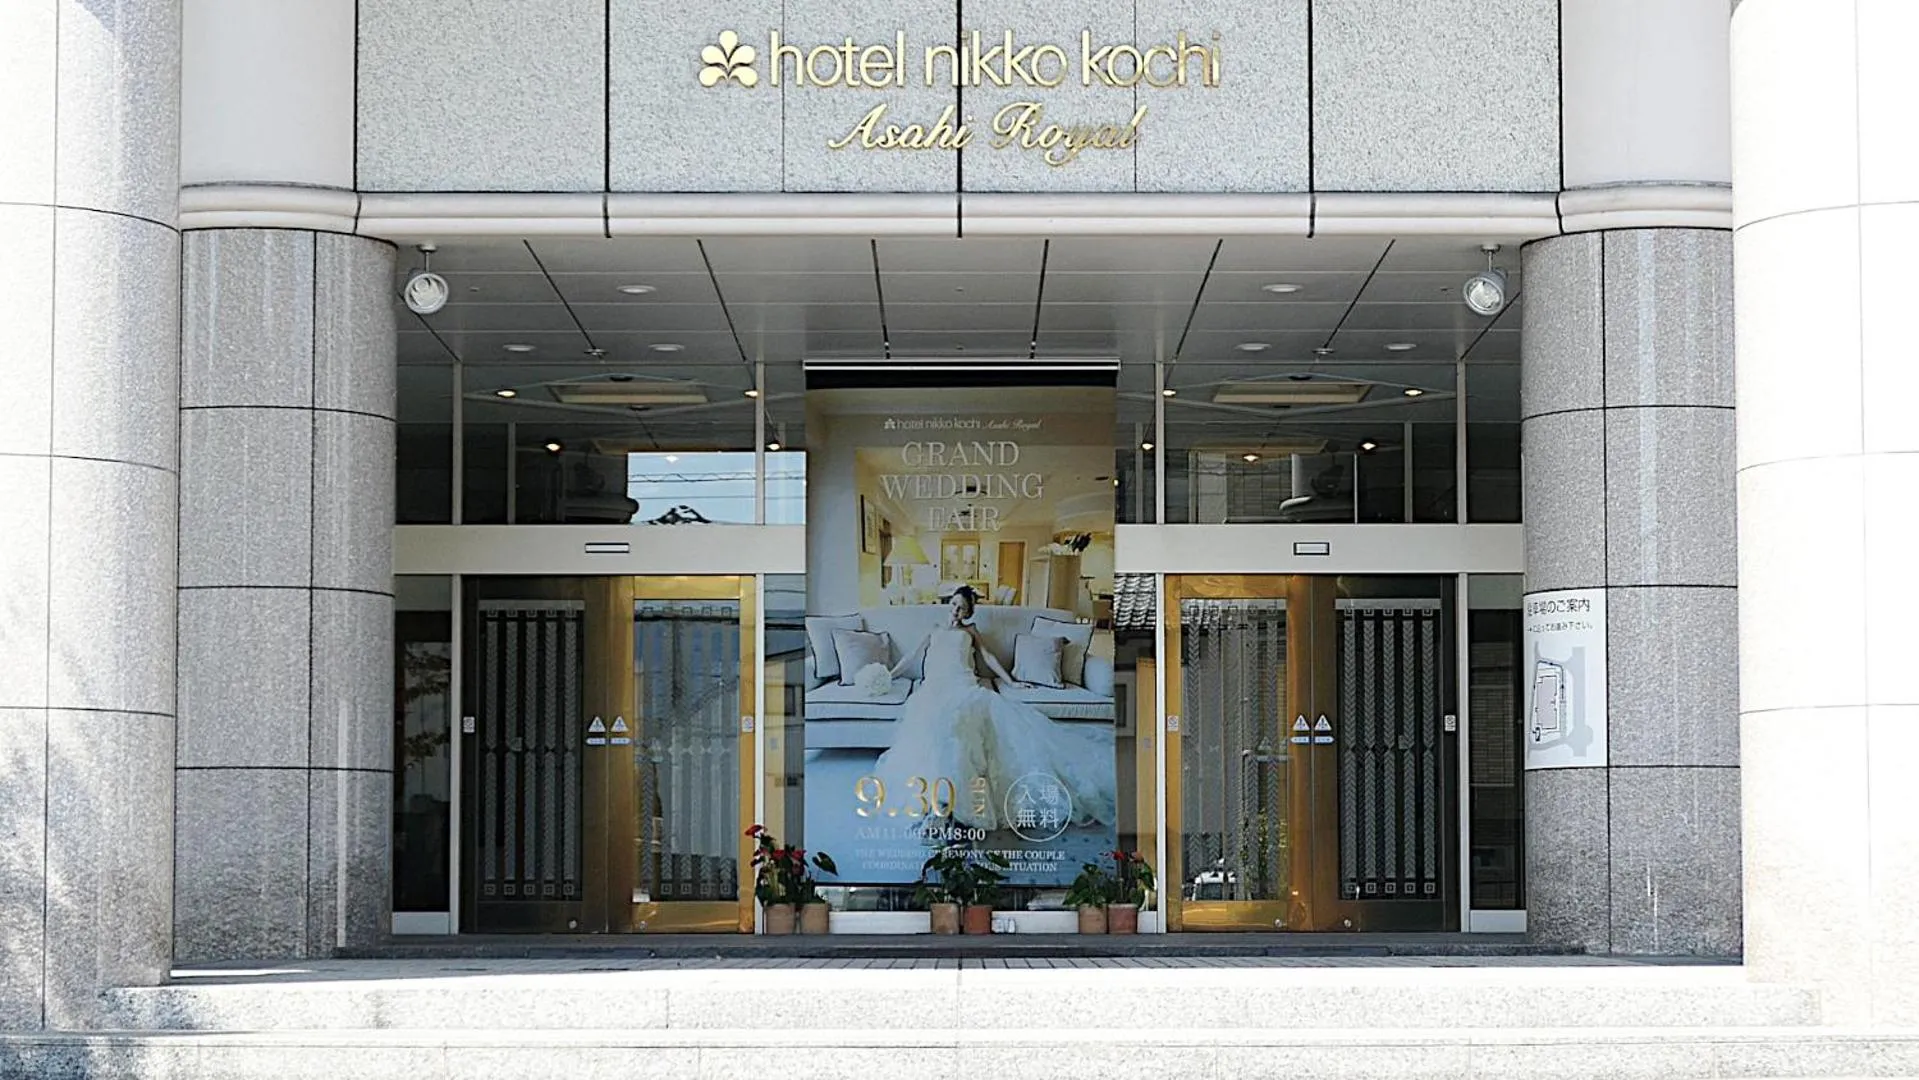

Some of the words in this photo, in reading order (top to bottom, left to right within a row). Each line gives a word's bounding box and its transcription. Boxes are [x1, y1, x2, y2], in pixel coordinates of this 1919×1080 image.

[769, 31, 905, 88] hotel
[925, 31, 1068, 88] nikko
[1082, 31, 1221, 88] kochi
[829, 103, 974, 150] Asahi
[991, 102, 1148, 167] Royal
[897, 418, 924, 430] hotel
[925, 418, 953, 430] nikko
[954, 418, 981, 429] kochi
[901, 441, 1020, 466] GRAND
[880, 472, 1044, 499] WEDDING
[927, 505, 1001, 532] FAIR
[854, 775, 956, 818] 9.30
[970, 776, 986, 818] SUN
[1016, 783, 1059, 805] 入場
[1016, 807, 1059, 829] 無料
[1002, 850, 1023, 860] THE
[1024, 850, 1066, 860] COUPLE
